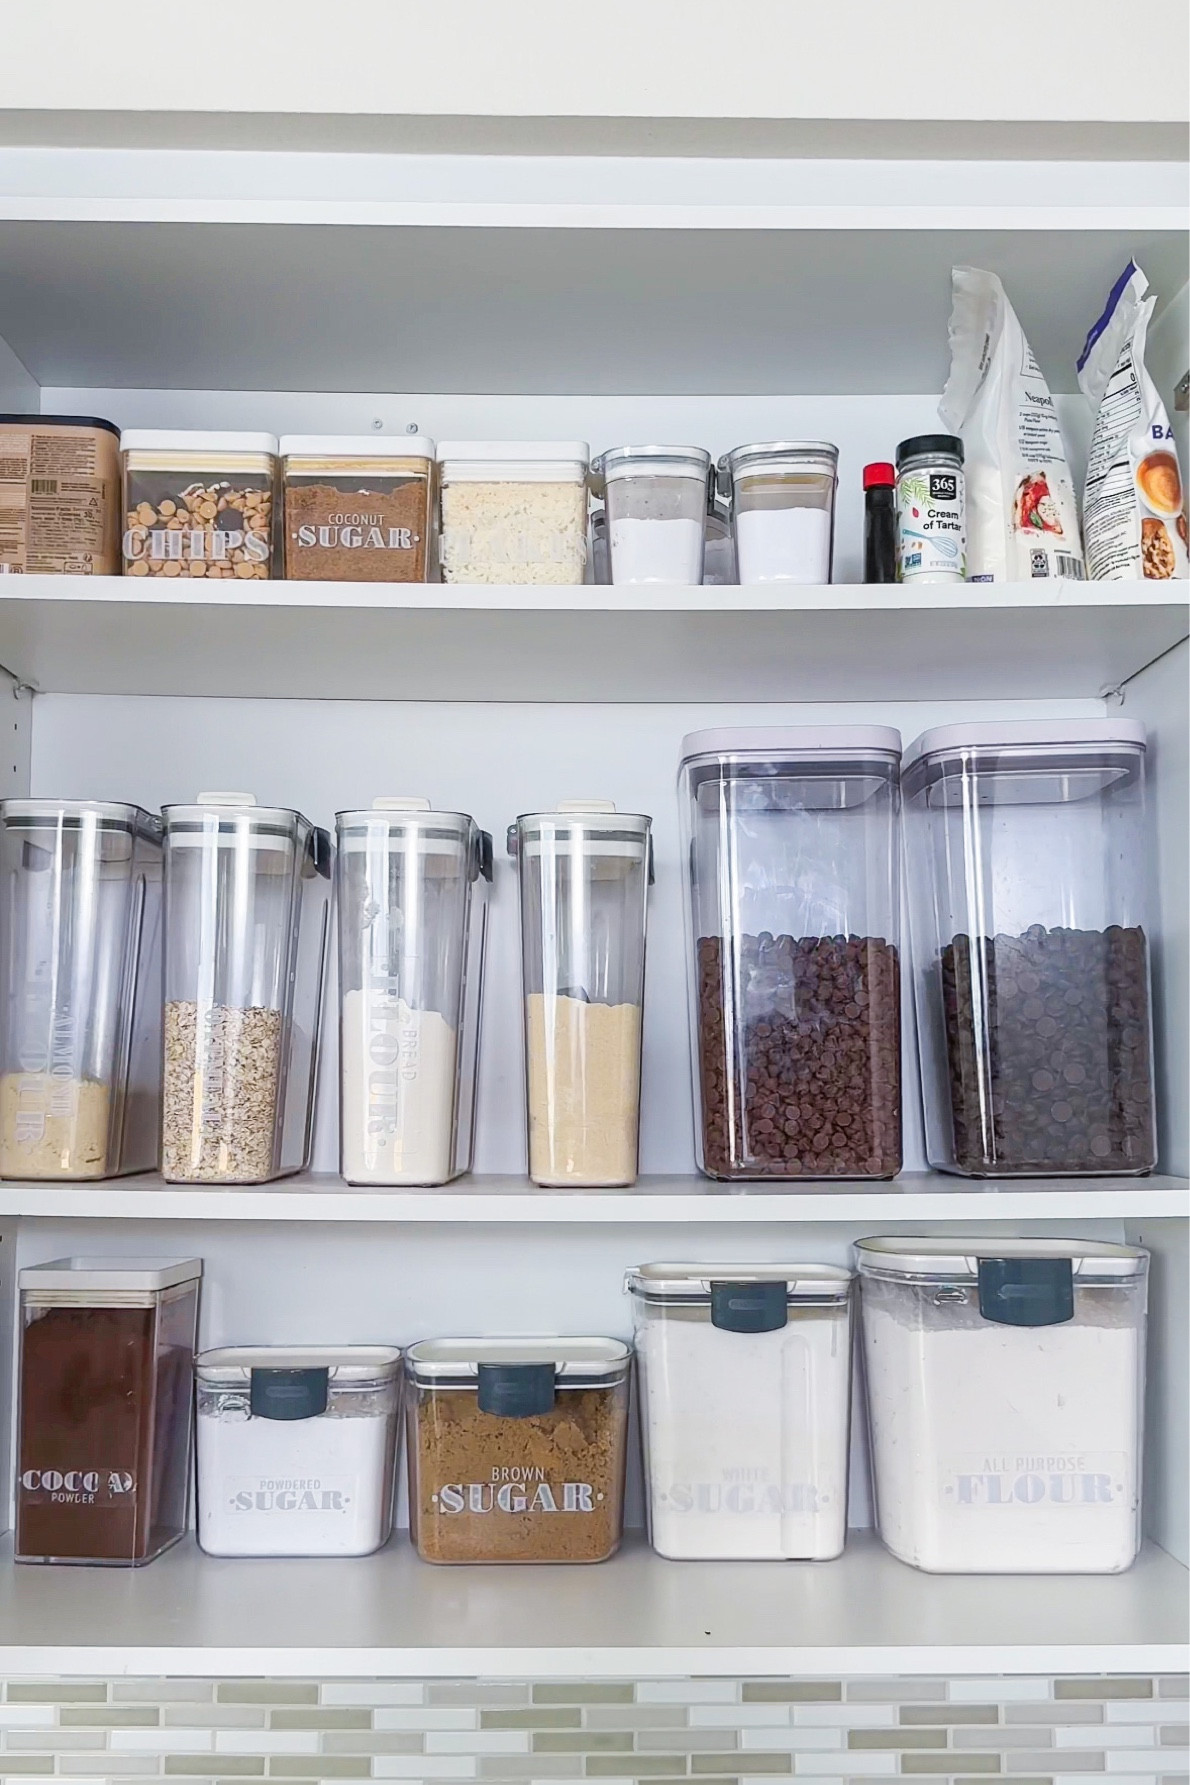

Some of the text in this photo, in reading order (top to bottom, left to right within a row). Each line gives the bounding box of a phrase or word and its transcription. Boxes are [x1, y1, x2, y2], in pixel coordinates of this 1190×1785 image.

[931, 477, 955, 492] 365
[328, 513, 386, 526] COCONUT
[927, 509, 959, 520] Cream
[923, 520, 962, 532] of Tartar
[122, 530, 269, 562] CHIPS
[299, 525, 414, 549] SUGAR
[368, 974, 400, 1137] FLOUR
[402, 1029, 418, 1081] BREAD
[983, 1456, 1085, 1472] ALL PURPOSE
[491, 1466, 545, 1482] BROWN
[260, 1479, 321, 1490] POWDERED
[955, 1473, 1114, 1504] FLOUR
[51, 1493, 95, 1504] POWDER
[235, 1490, 345, 1511] SUGAR
[439, 1482, 596, 1513] SUGAR
[669, 1483, 819, 1513] SUGAR
